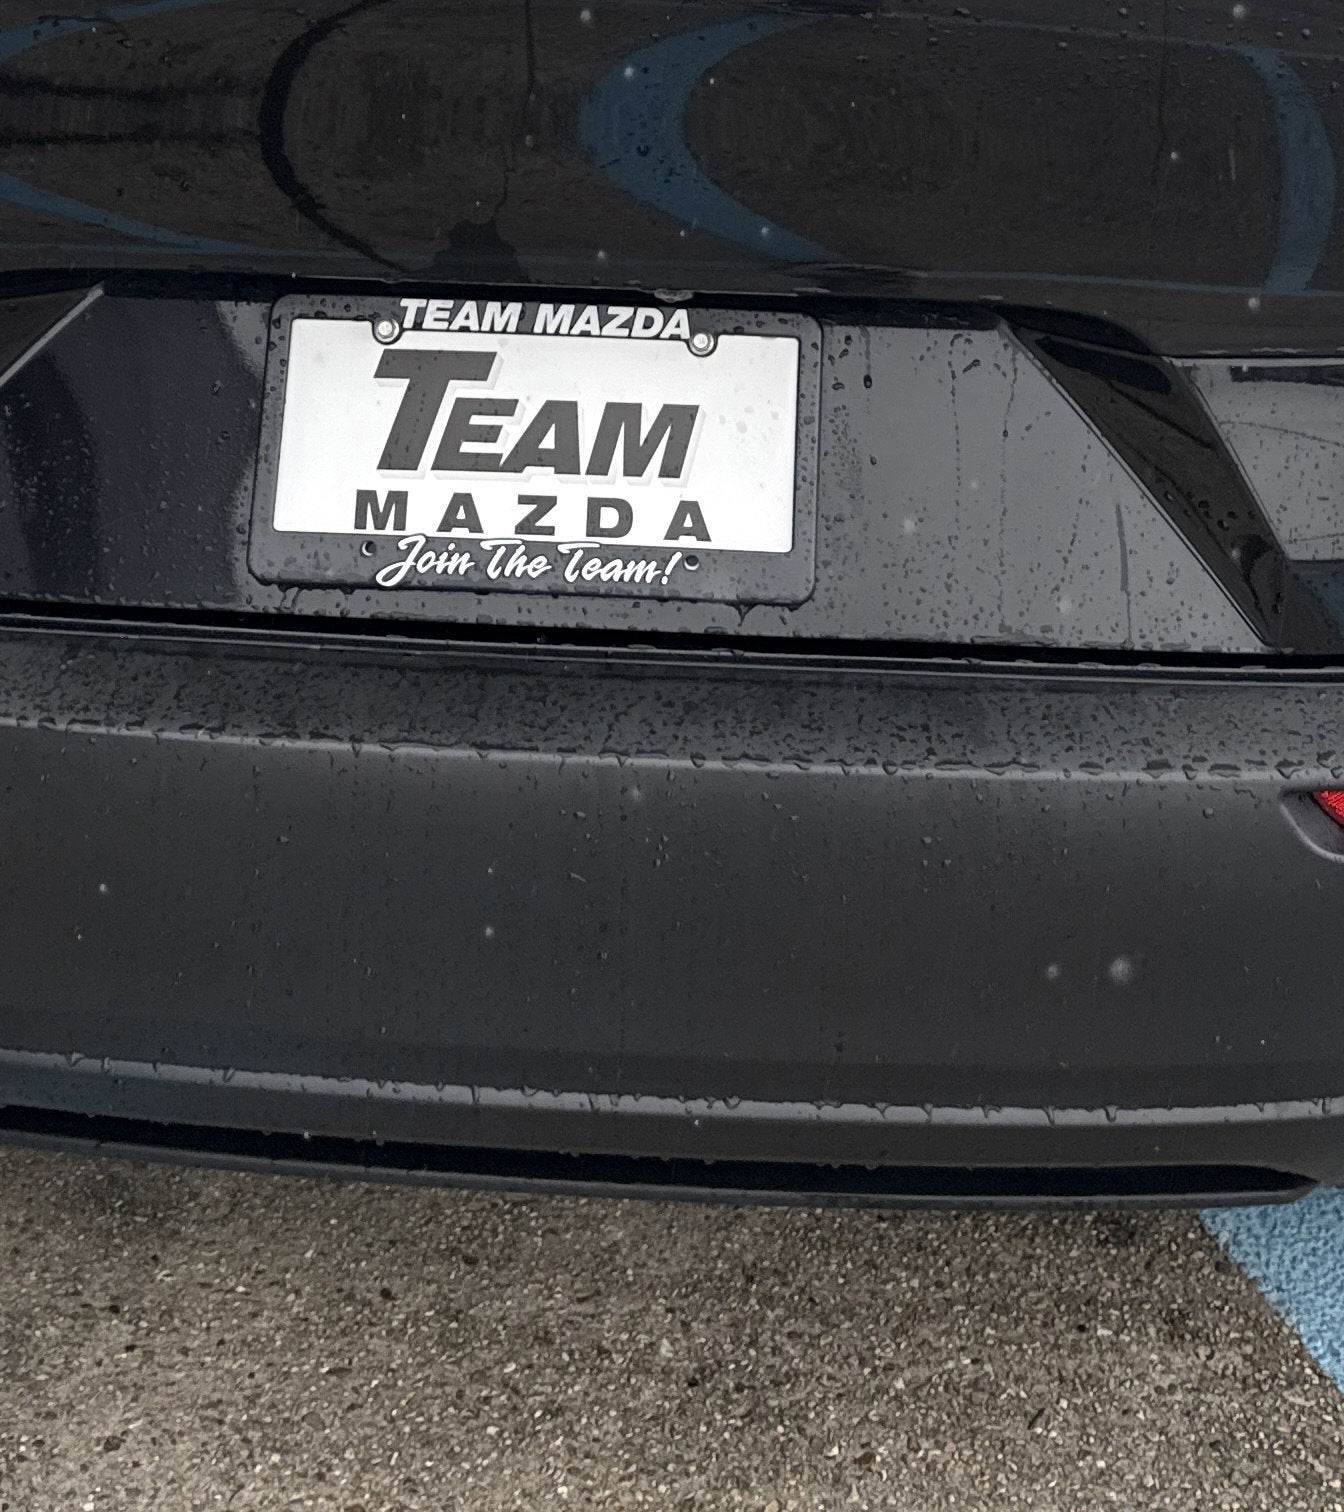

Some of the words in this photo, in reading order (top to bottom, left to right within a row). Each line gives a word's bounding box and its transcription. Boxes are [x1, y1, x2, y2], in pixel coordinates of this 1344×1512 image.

[399, 297, 522, 333] TEAM
[532, 303, 691, 339] MAZDA
[355, 490, 712, 542] MAZDA
[376, 533, 475, 587] Join
[480, 537, 552, 578] The
[556, 541, 682, 585] Team!
